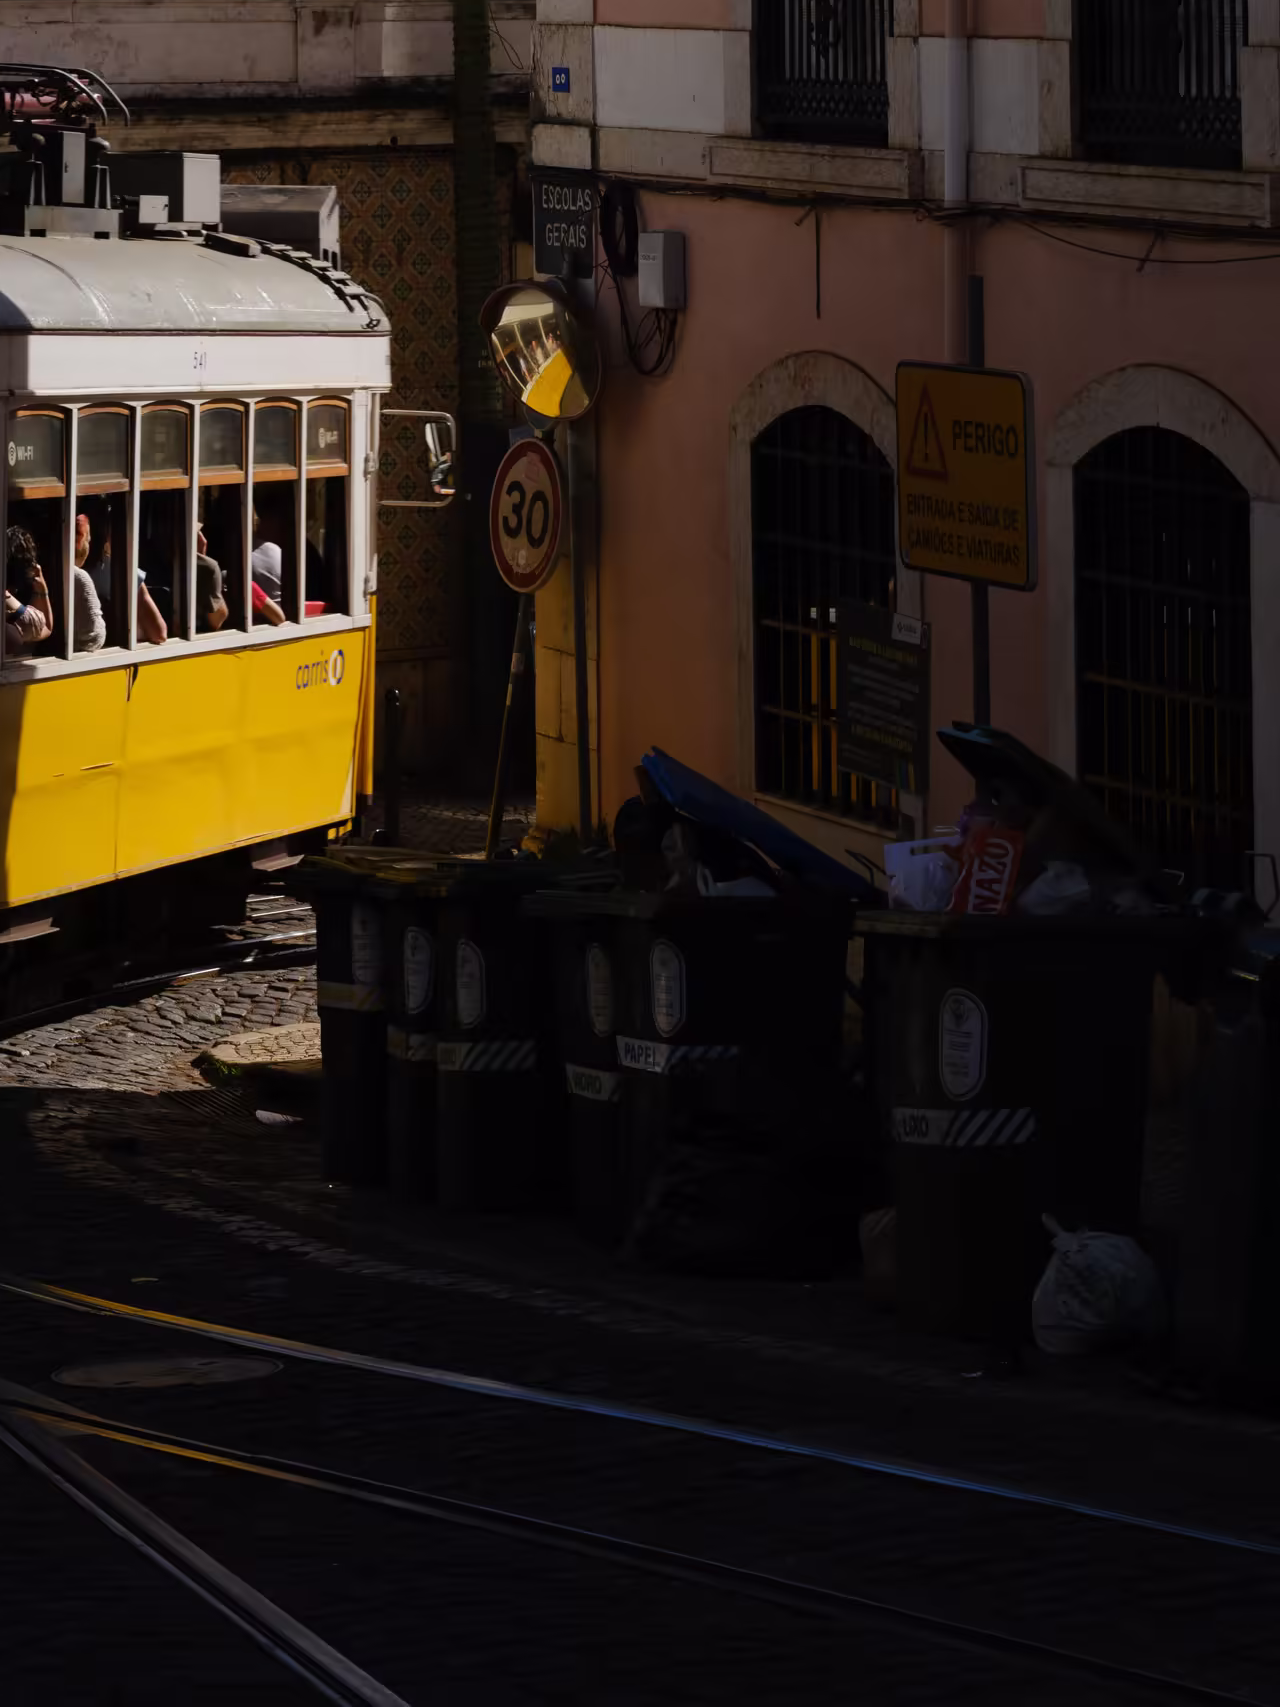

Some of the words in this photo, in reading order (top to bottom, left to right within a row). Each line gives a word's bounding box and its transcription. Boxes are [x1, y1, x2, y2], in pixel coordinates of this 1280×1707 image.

[542, 184, 592, 211] ESCOLAS
[546, 223, 587, 249] GERAIS
[193, 351, 207, 371] 541
[952, 419, 1019, 459] PERIGO
[502, 480, 550, 550] 30
[906, 493, 956, 522] ENTRADA
[958, 501, 966, 522] E
[1002, 507, 1020, 533] DE
[956, 535, 965, 557] E
[966, 536, 1020, 567] VIATURAS
[624, 1041, 658, 1068] PAPEL
